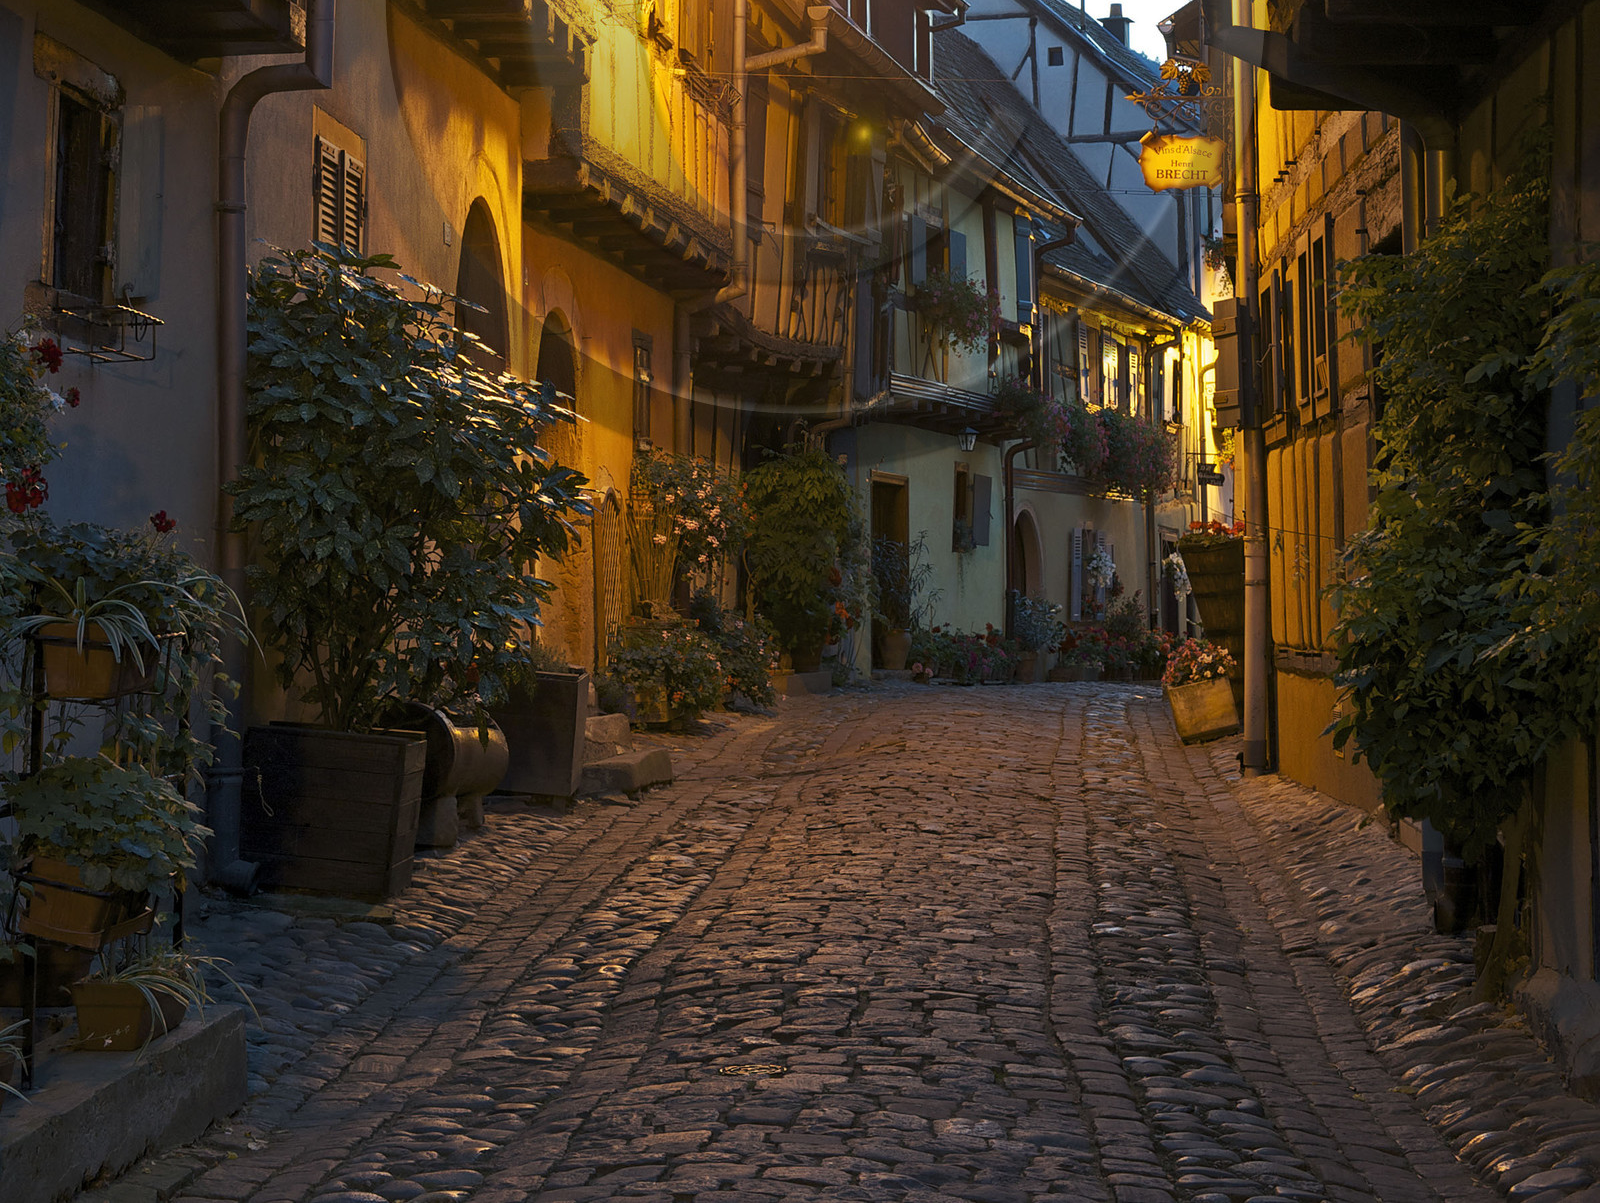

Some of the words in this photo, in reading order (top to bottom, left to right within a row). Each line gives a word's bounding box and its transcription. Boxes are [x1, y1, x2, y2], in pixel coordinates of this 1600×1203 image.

[1175, 145, 1213, 158] d'Alsace
[1170, 159, 1194, 168] Henri
[1156, 169, 1208, 180] BRECHT
